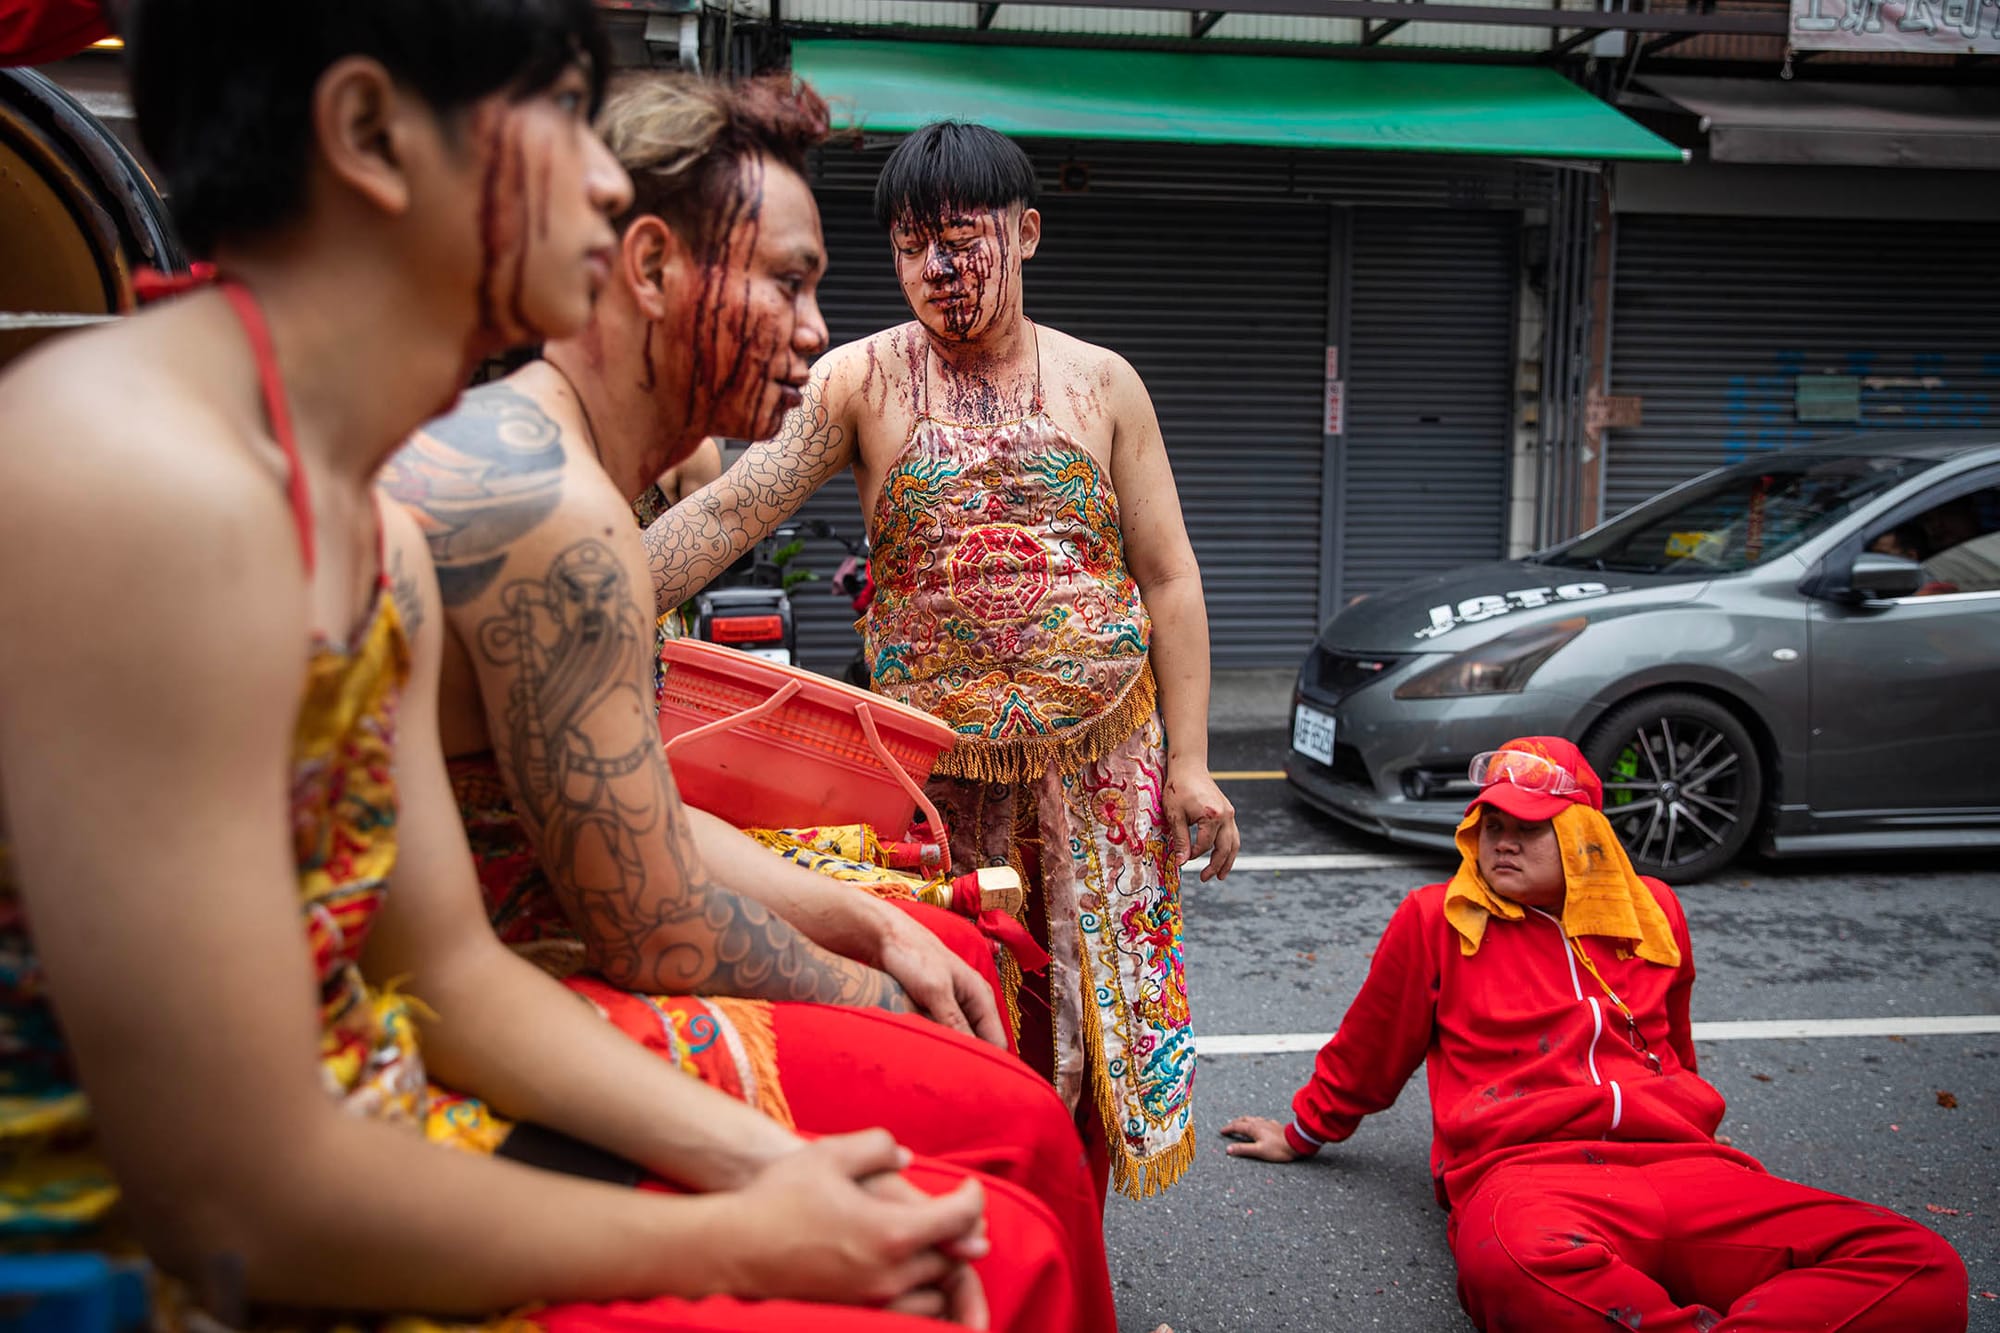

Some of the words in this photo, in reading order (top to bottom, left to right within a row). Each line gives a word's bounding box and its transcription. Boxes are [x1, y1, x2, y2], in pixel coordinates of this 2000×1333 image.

[983, 495, 1010, 521] 合
[1058, 558, 1082, 586] 平
[996, 627, 1024, 655] 境
